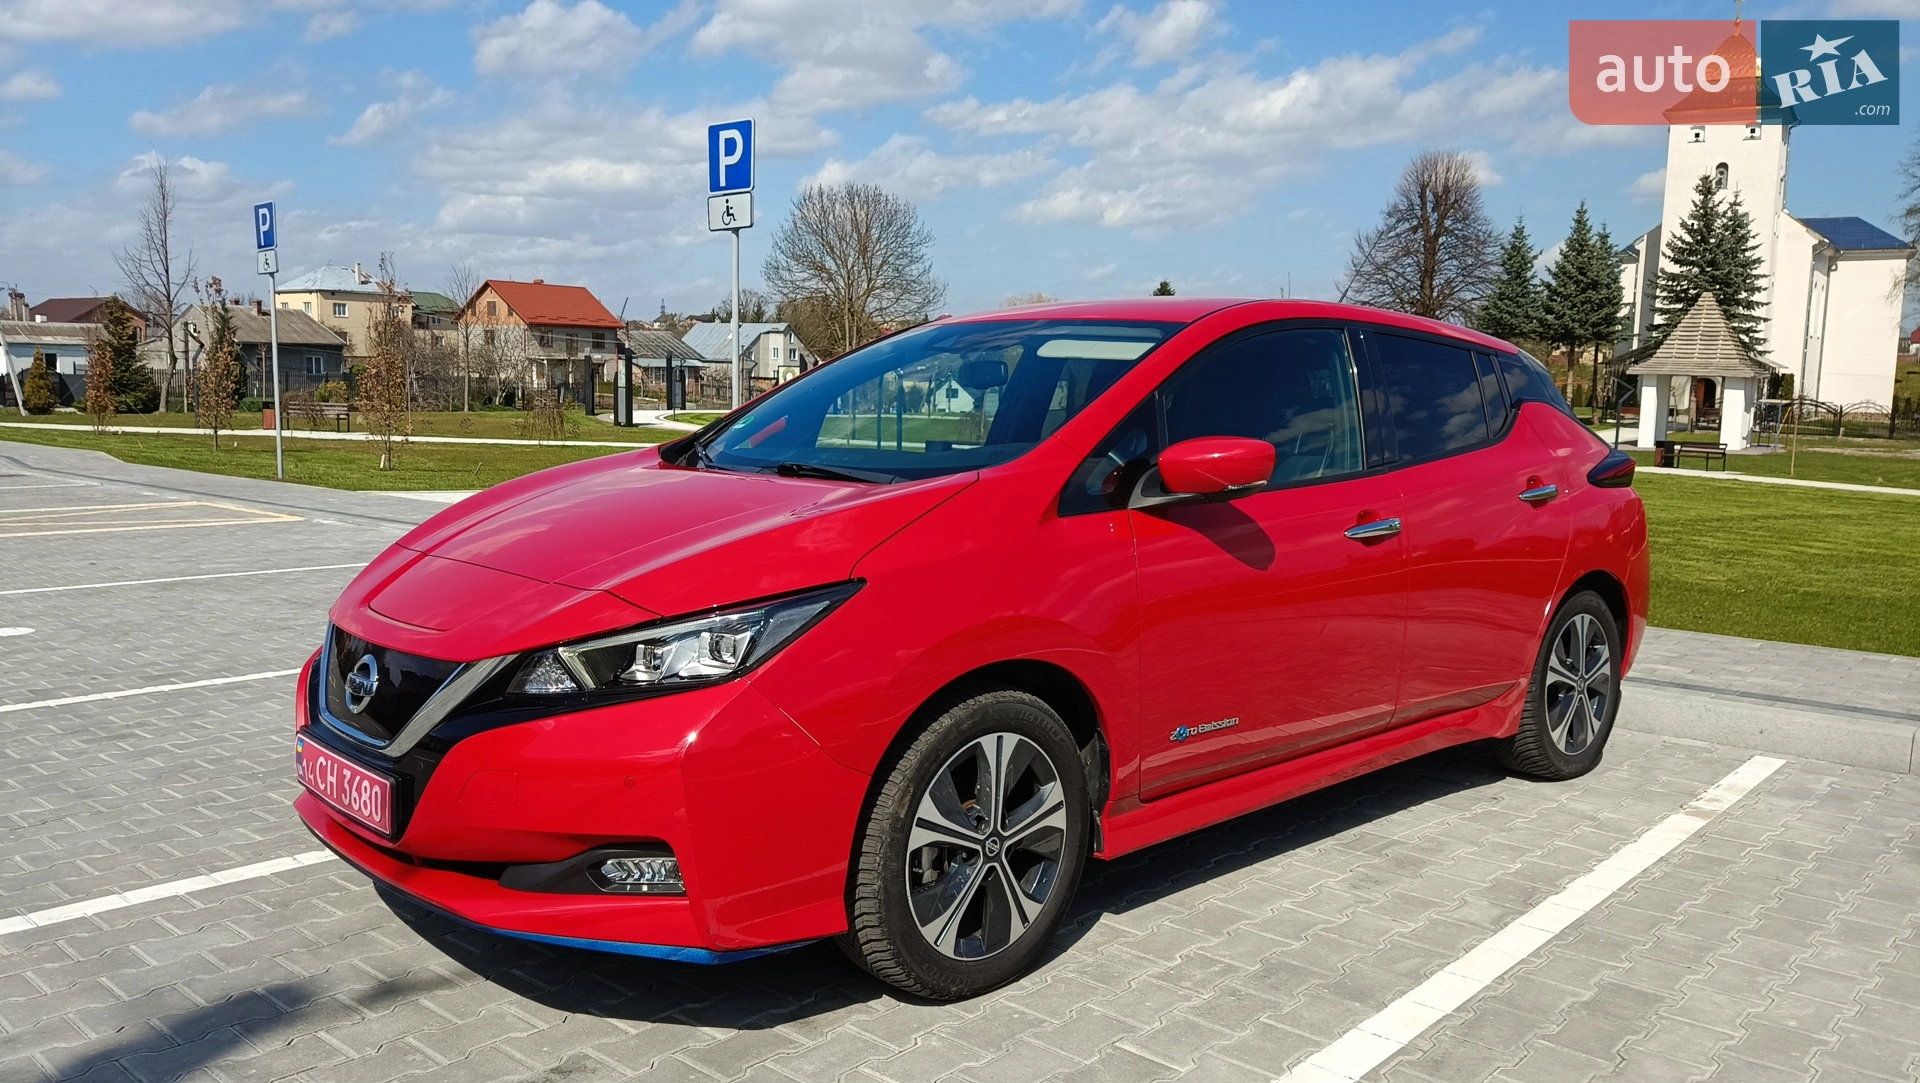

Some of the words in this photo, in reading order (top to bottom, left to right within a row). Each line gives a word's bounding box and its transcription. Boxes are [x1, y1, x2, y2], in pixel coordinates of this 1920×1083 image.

[719, 128, 744, 187] P
[258, 207, 271, 246] P
[1198, 717, 1239, 733] Emission
[302, 758, 315, 786] 14
[316, 756, 338, 799] CH
[341, 768, 381, 823] 3680
